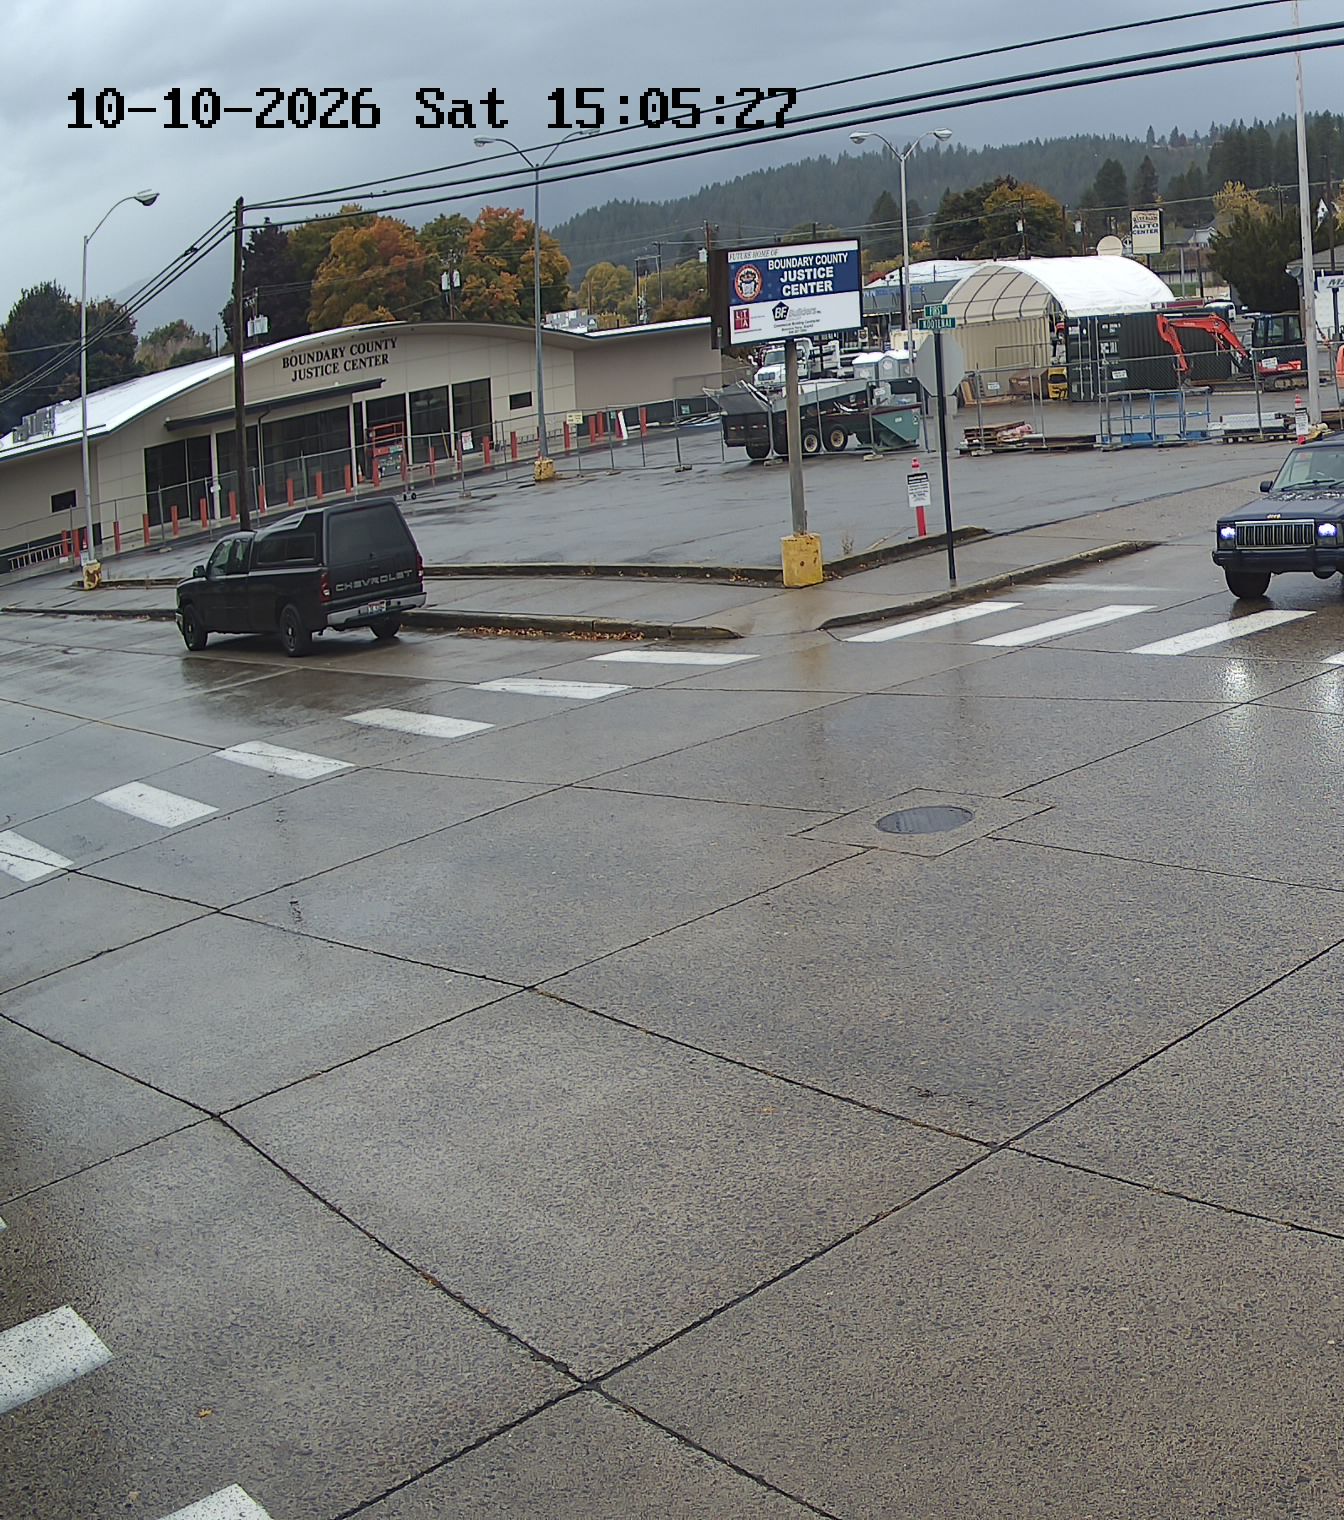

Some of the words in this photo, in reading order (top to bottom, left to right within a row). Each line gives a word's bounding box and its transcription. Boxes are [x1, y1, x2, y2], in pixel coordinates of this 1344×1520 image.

[768, 255, 814, 271] BOUNDARY
[815, 252, 848, 265] COUNTY
[779, 266, 834, 283] JUSTICE
[782, 280, 833, 297] CENTER
[282, 346, 346, 369] BOUNDARY
[349, 336, 398, 356] COUNTY
[291, 362, 340, 383] JUSTICE
[343, 353, 390, 372] CENTER
[335, 569, 413, 592] CHEVROLET
